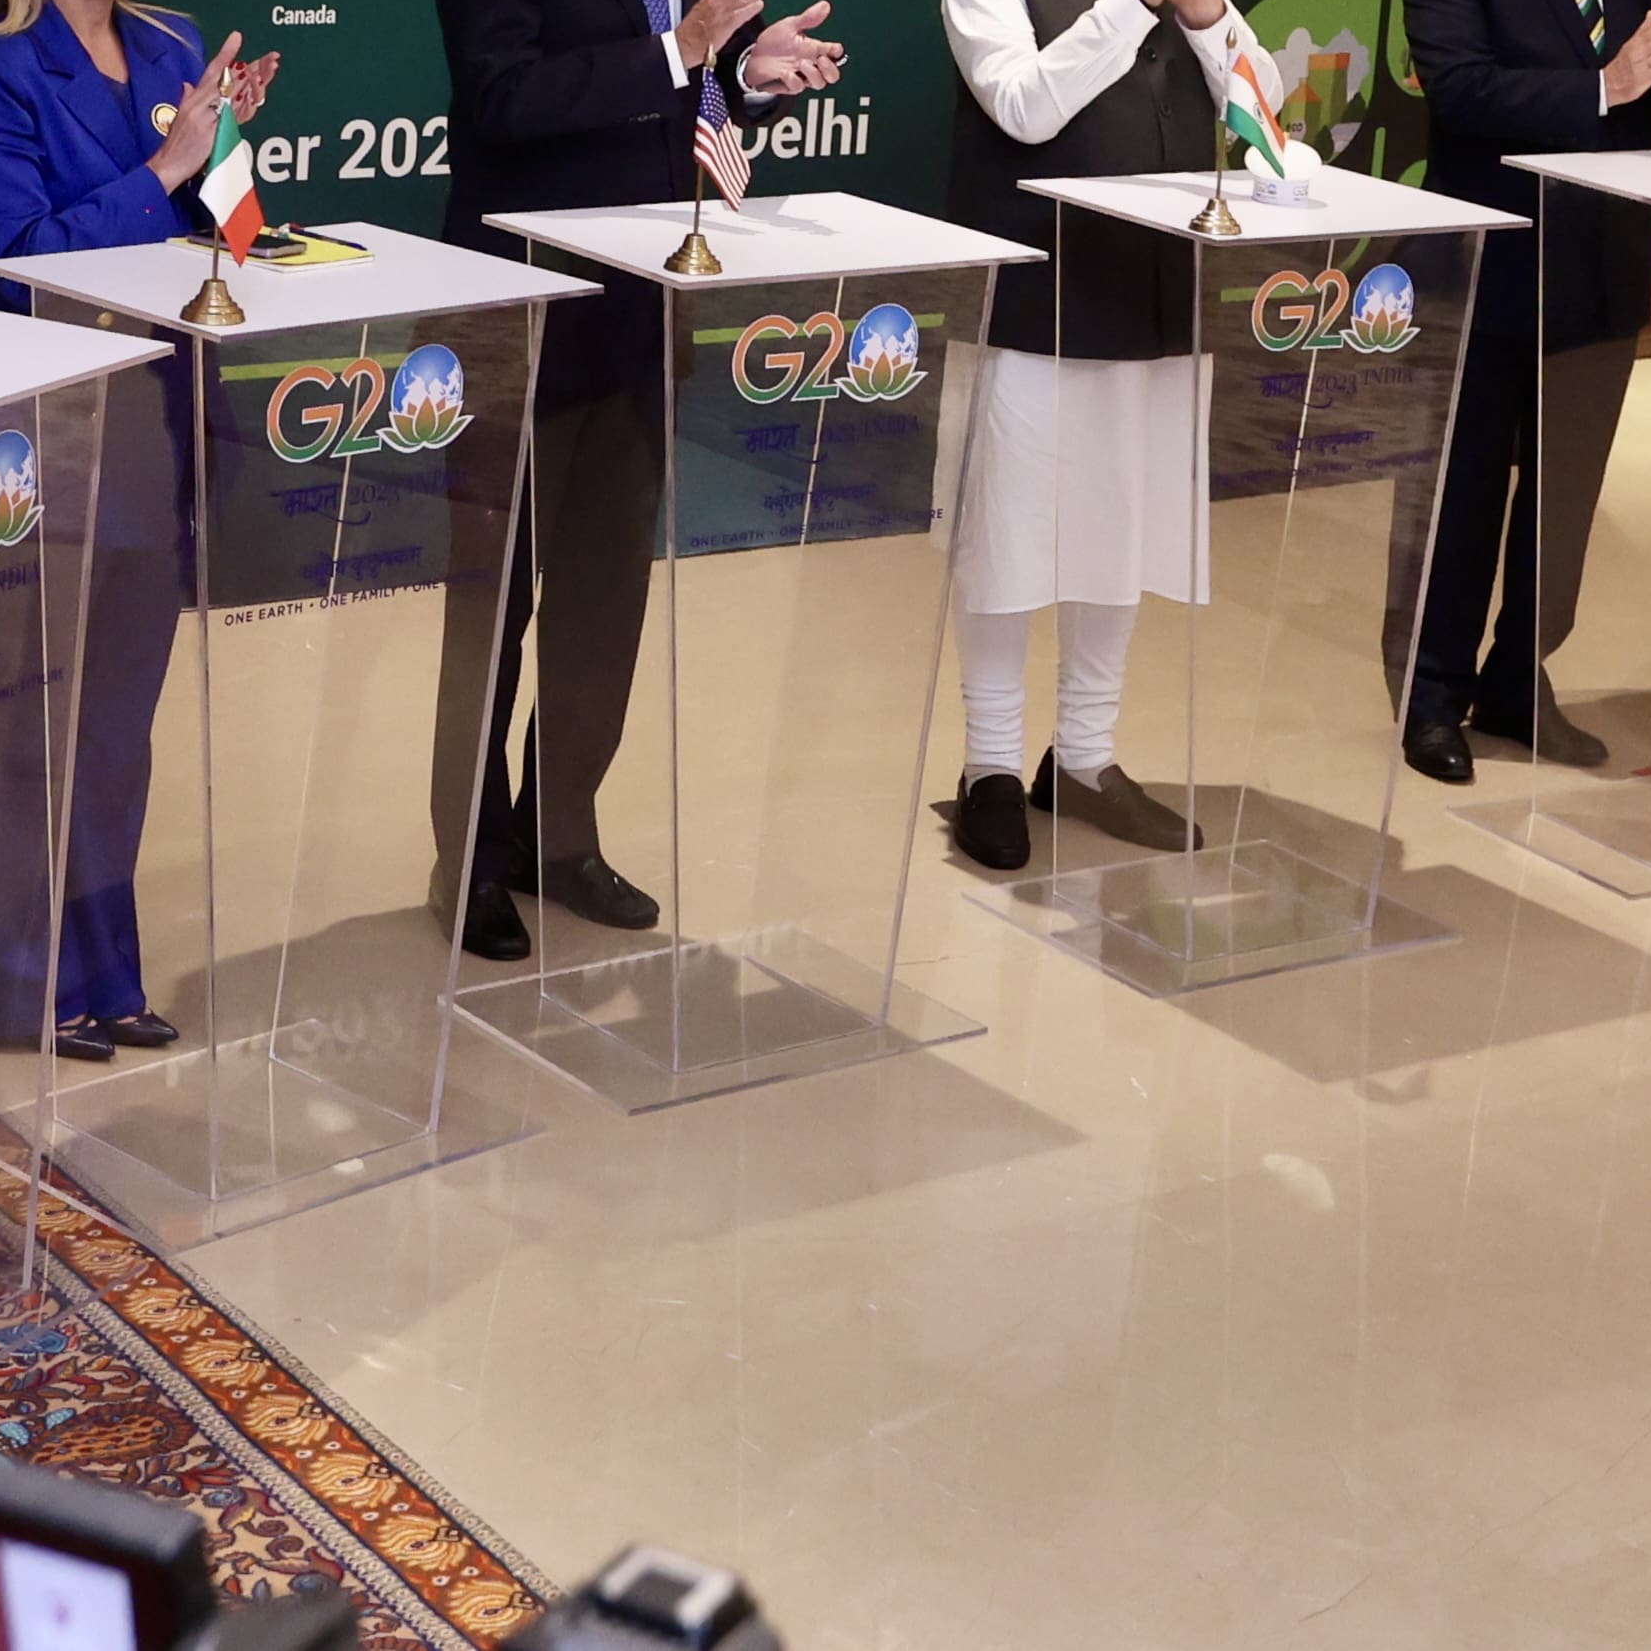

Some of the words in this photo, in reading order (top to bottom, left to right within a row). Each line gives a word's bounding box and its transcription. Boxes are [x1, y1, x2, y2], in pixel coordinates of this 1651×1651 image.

[271, 4, 337, 25] Canada
[732, 302, 928, 404] G20
[1251, 263, 1421, 353] G20
[267, 343, 475, 464] G20
[224, 610, 254, 627] ONE
[258, 602, 304, 621] EARTH
[319, 594, 348, 611] ONE
[351, 586, 397, 604] FAMILY
